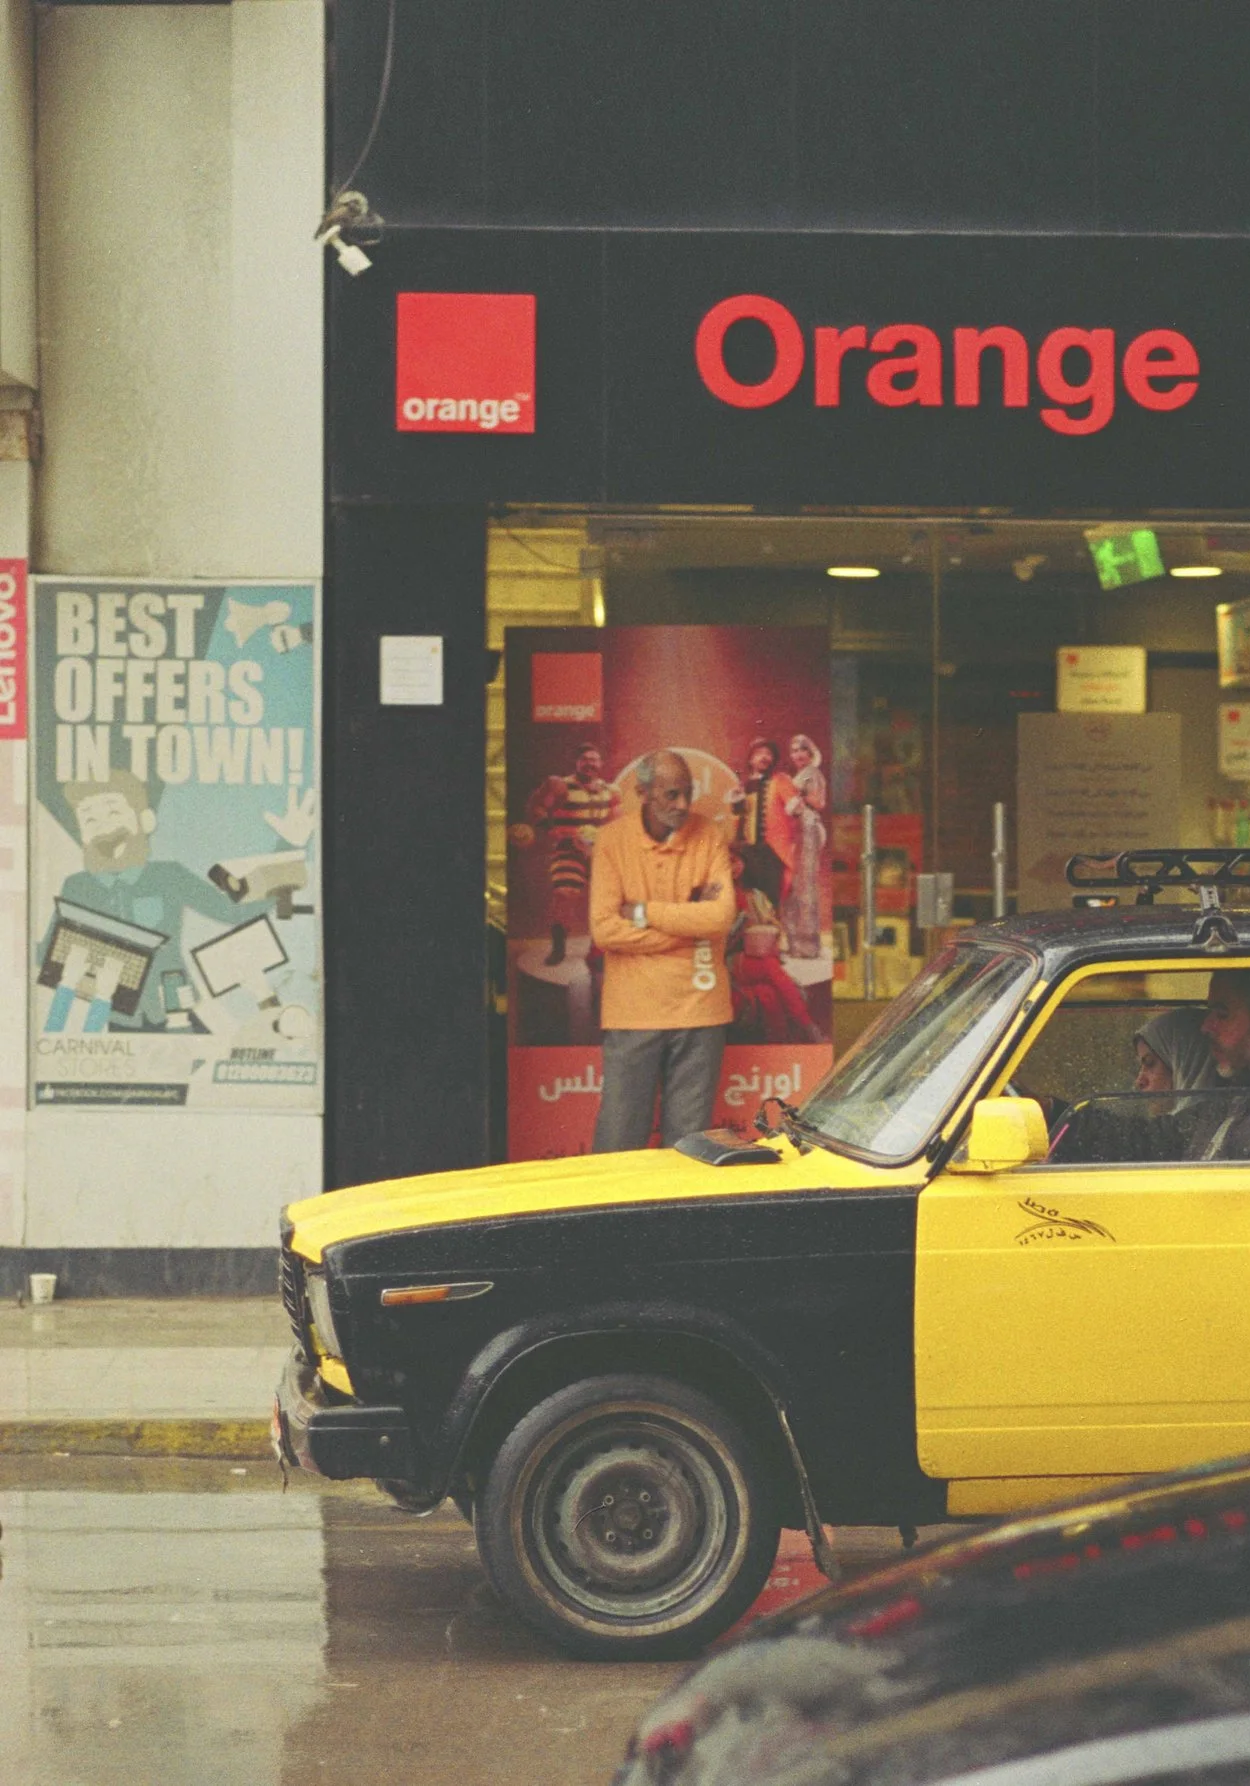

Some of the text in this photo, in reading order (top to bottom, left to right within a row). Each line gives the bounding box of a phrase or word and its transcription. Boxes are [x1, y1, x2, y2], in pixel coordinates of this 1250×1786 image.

[695, 294, 1200, 436] Orange
[402, 397, 521, 429] orange
[56, 592, 205, 658] BEST
[54, 657, 264, 725] OFFERS
[56, 725, 305, 785] IN TOWN!
[36, 1039, 135, 1056] CARNIVAL
[724, 1063, 801, 1107] اورنج
